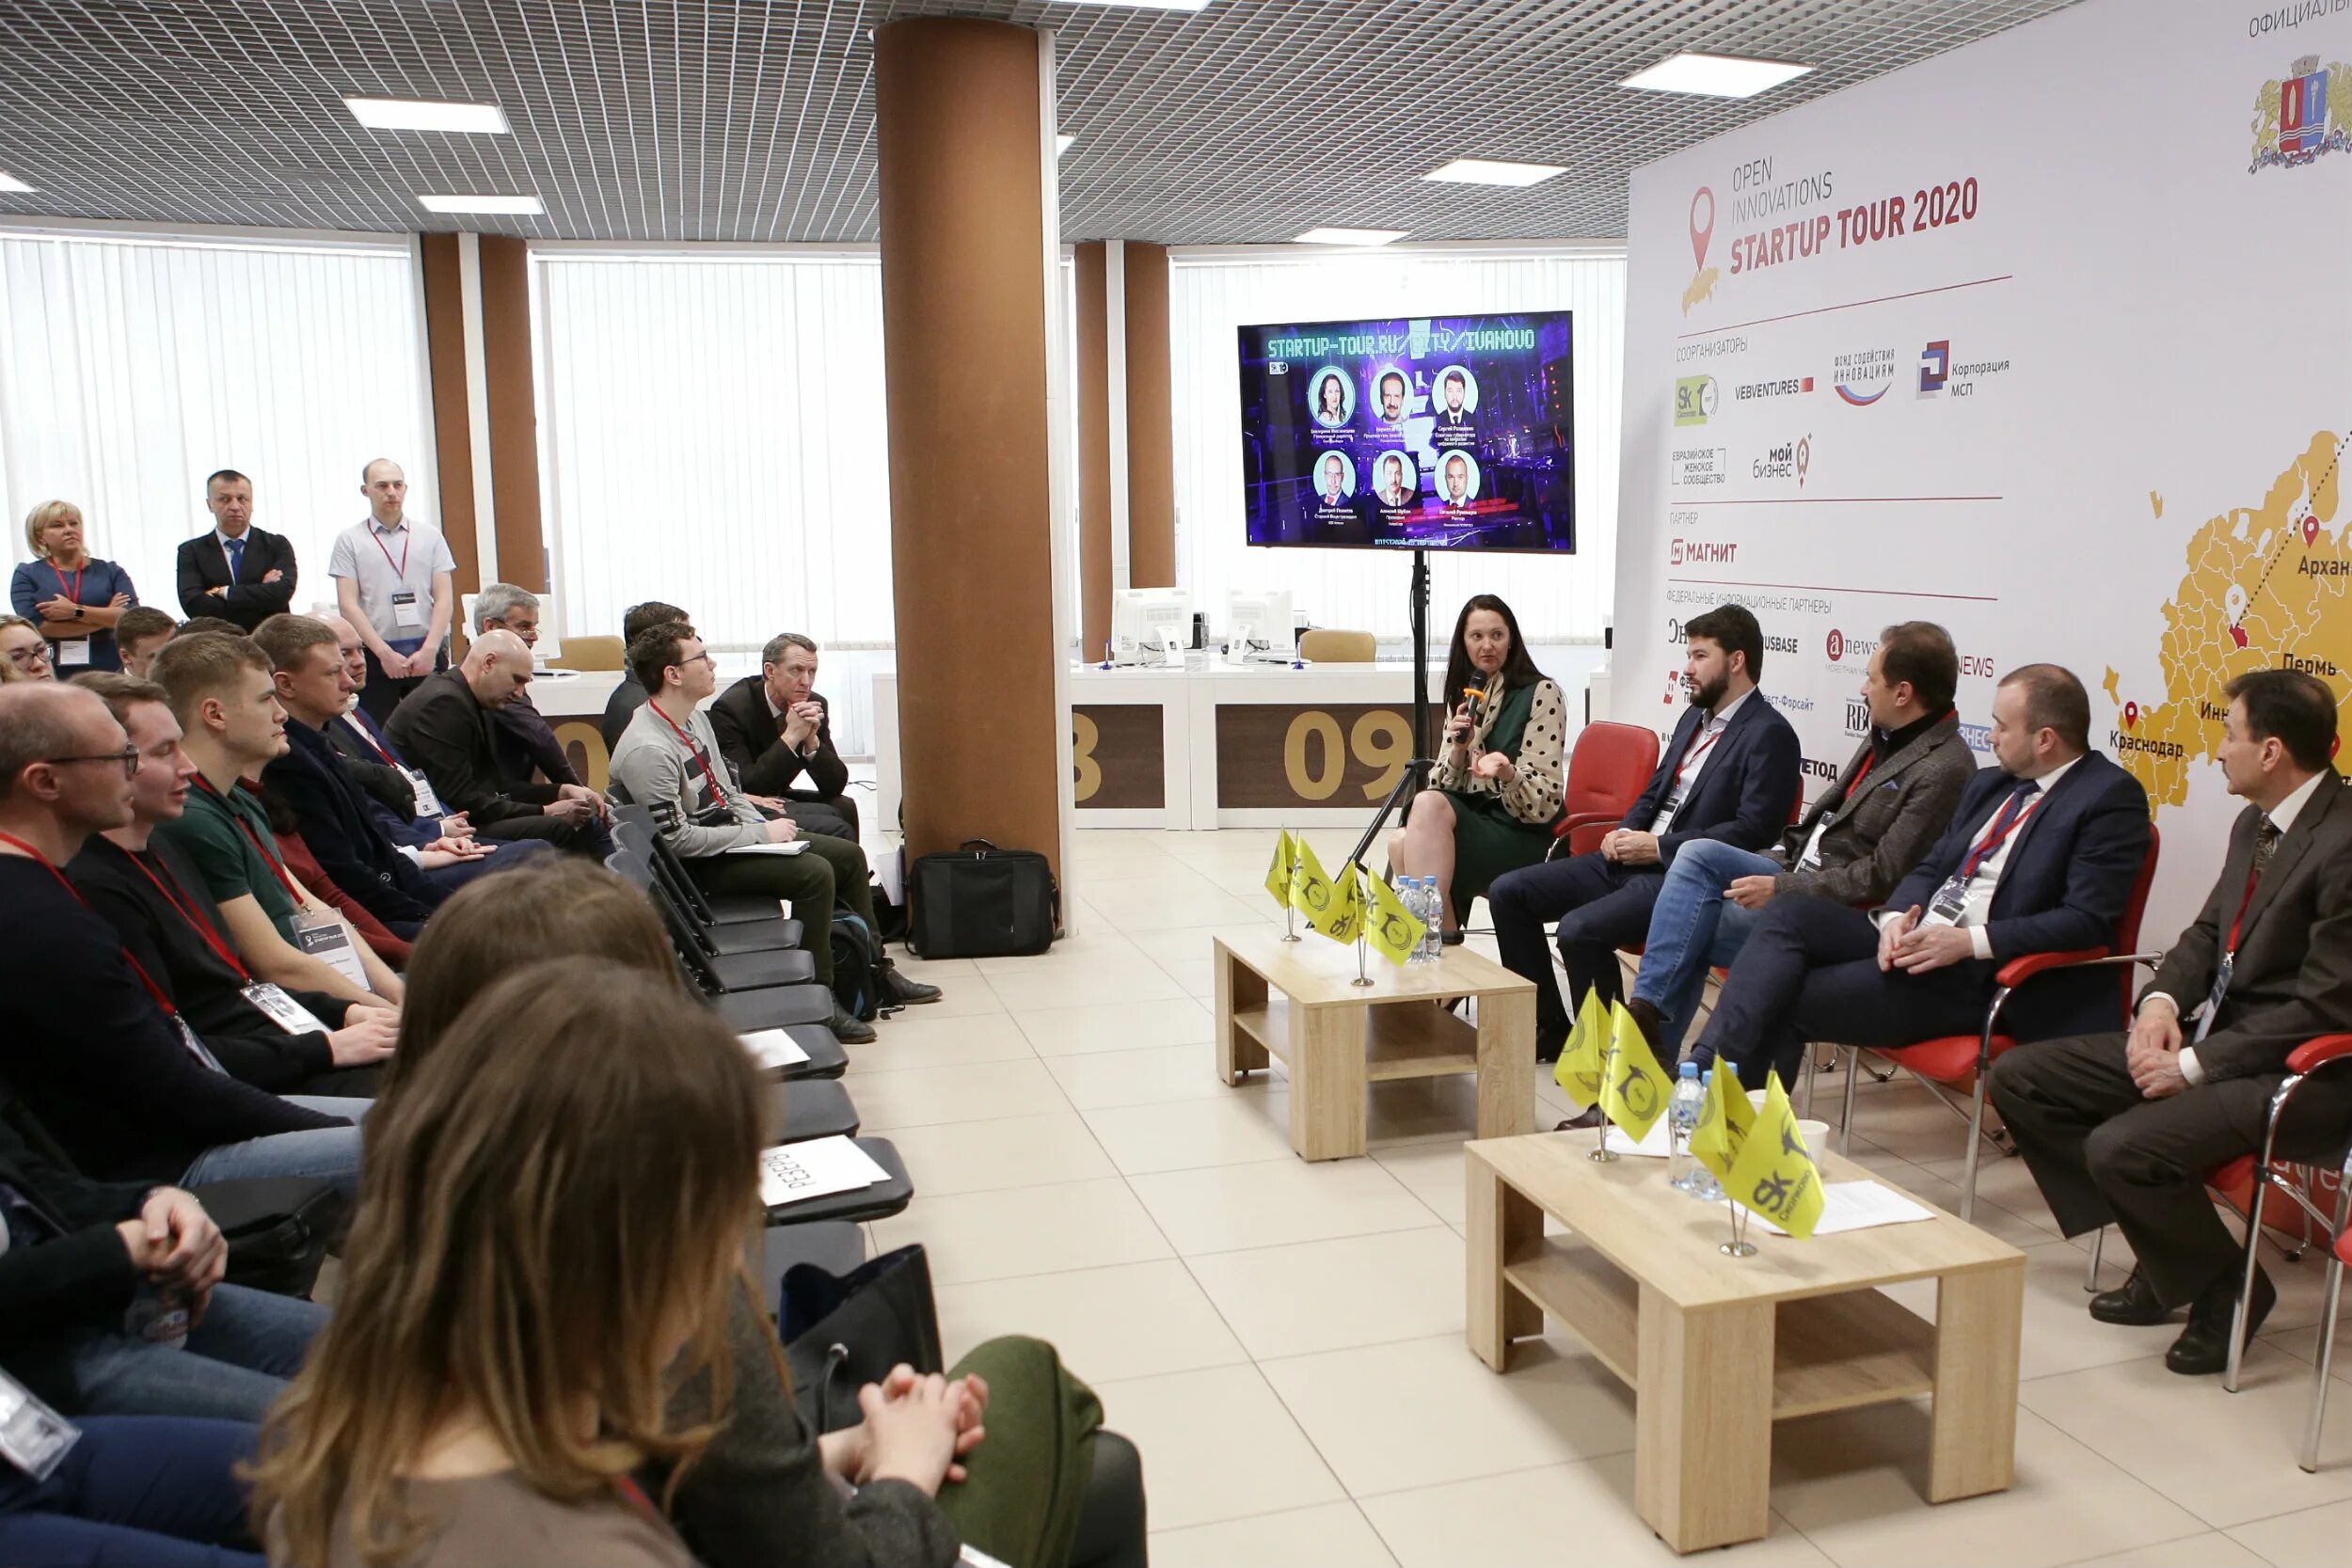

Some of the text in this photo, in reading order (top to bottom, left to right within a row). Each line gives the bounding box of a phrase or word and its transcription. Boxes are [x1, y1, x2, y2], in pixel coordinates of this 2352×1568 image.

[2249, 0, 2352, 38] ОФИЦИАЛЬ
[1732, 155, 1773, 192] OPEN
[1731, 171, 1834, 225] INNOVATIONS
[1730, 176, 1979, 275] STARTUP TOUR 2020
[1677, 336, 1748, 362] СООРГАНИЗАТОРЫ
[1835, 348, 1895, 367] ФОНД СОДЕЙСТВИЯ
[1834, 363, 1895, 383] ИННОВАЦИЯМ
[1951, 359, 2010, 379] Корпорация
[1735, 379, 1799, 401] VEBVENTURES
[1950, 383, 1973, 397] МСП
[1672, 449, 1714, 461] ЕВРАЗИЙСКОЕ
[1684, 461, 1713, 473] ЖЕНСКОЕ
[1753, 459, 1792, 479] бизнес
[1683, 474, 1725, 485] СООБЩЕСТВО
[1670, 512, 1699, 525] ПАРТНЕР
[1686, 543, 1738, 563] МАГНИТ
[2297, 555, 2352, 579] Архан
[1667, 590, 1833, 614] ФЕДЕРАЛЬНЫЕ ИНФОРМАЦИОННЫЕ ПАРТНЕРЫ
[1764, 635, 1799, 654] USBASE
[2283, 653, 2338, 676] Пермь
[1284, 710, 1413, 800] 09
[2109, 731, 2184, 759] Краснодар
[1801, 757, 1837, 783] ЕТОД
[1752, 1169, 1794, 1213] Sk
